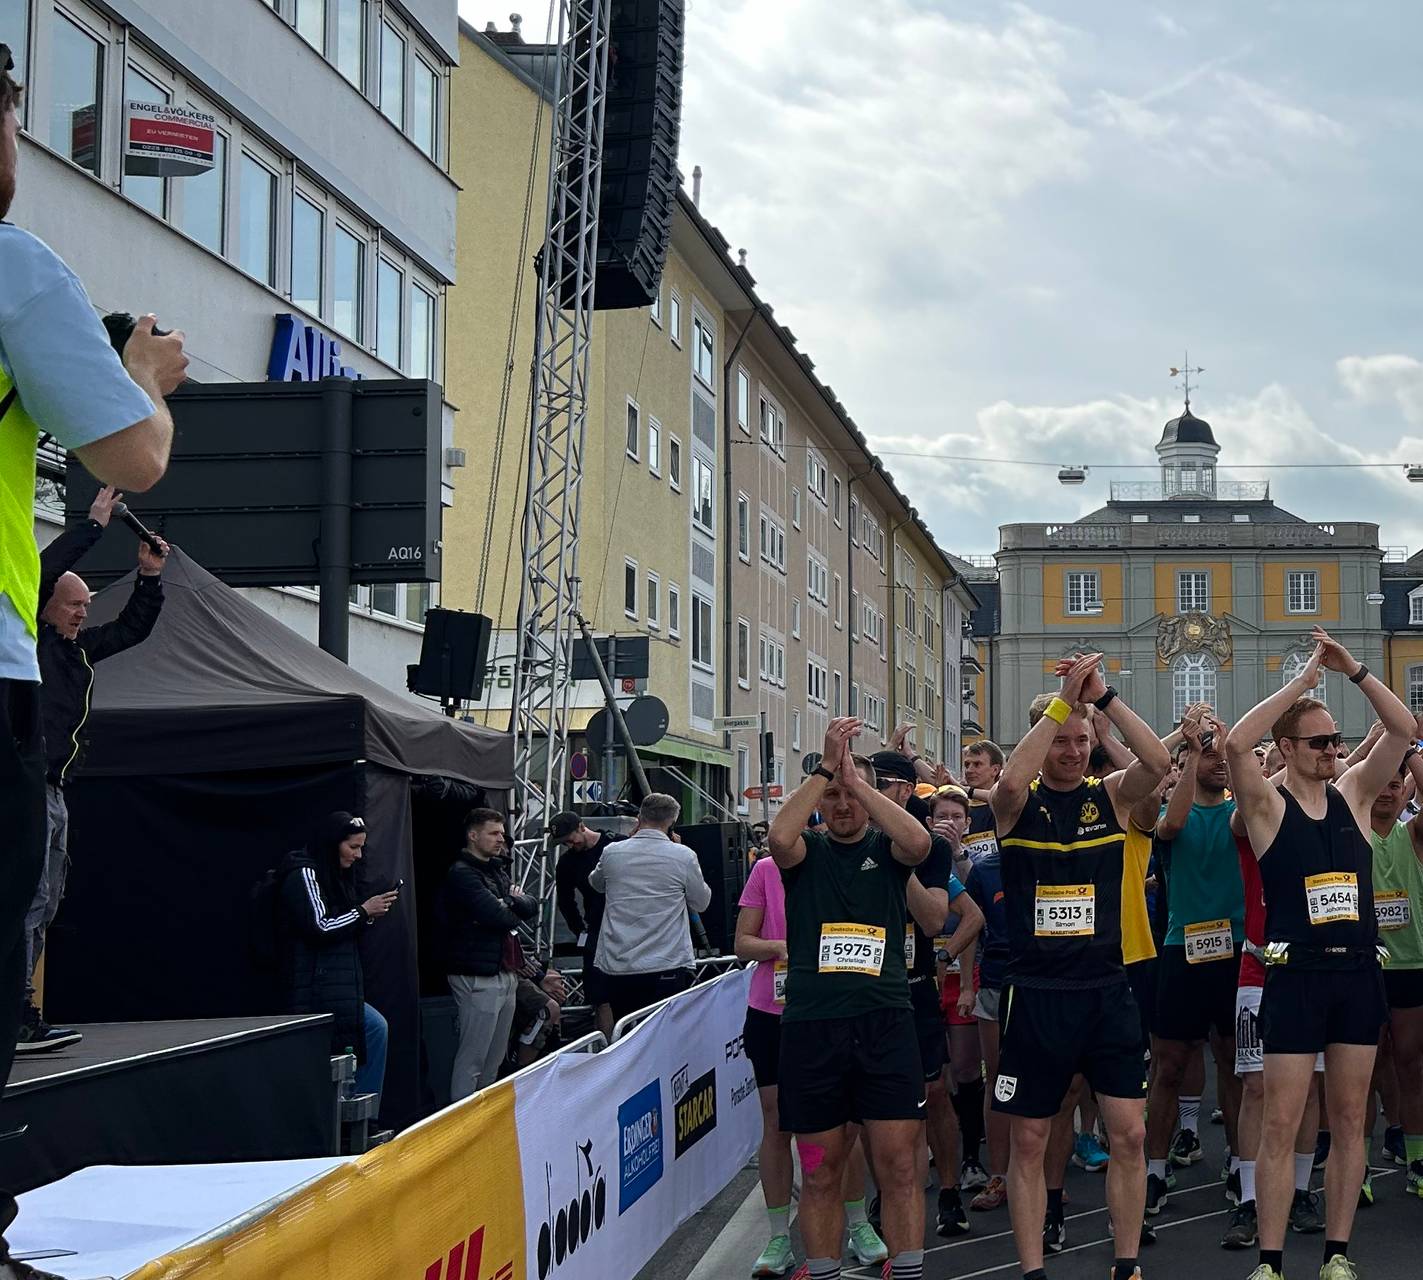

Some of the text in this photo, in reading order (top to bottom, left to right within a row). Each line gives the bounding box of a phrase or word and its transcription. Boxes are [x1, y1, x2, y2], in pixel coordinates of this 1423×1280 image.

[130, 103, 215, 122] ENGEL&VÖLKERS
[154, 114, 213, 129] COMMERCIAL
[388, 547, 422, 560] AQ16
[1320, 892, 1352, 906] 5454
[1048, 906, 1082, 920] 5313
[833, 943, 872, 957] 5975
[1195, 936, 1223, 950] 5915
[836, 956, 867, 964] Christian
[678, 1085, 715, 1142] STARCAR
[537, 1140, 608, 1280] diadora
